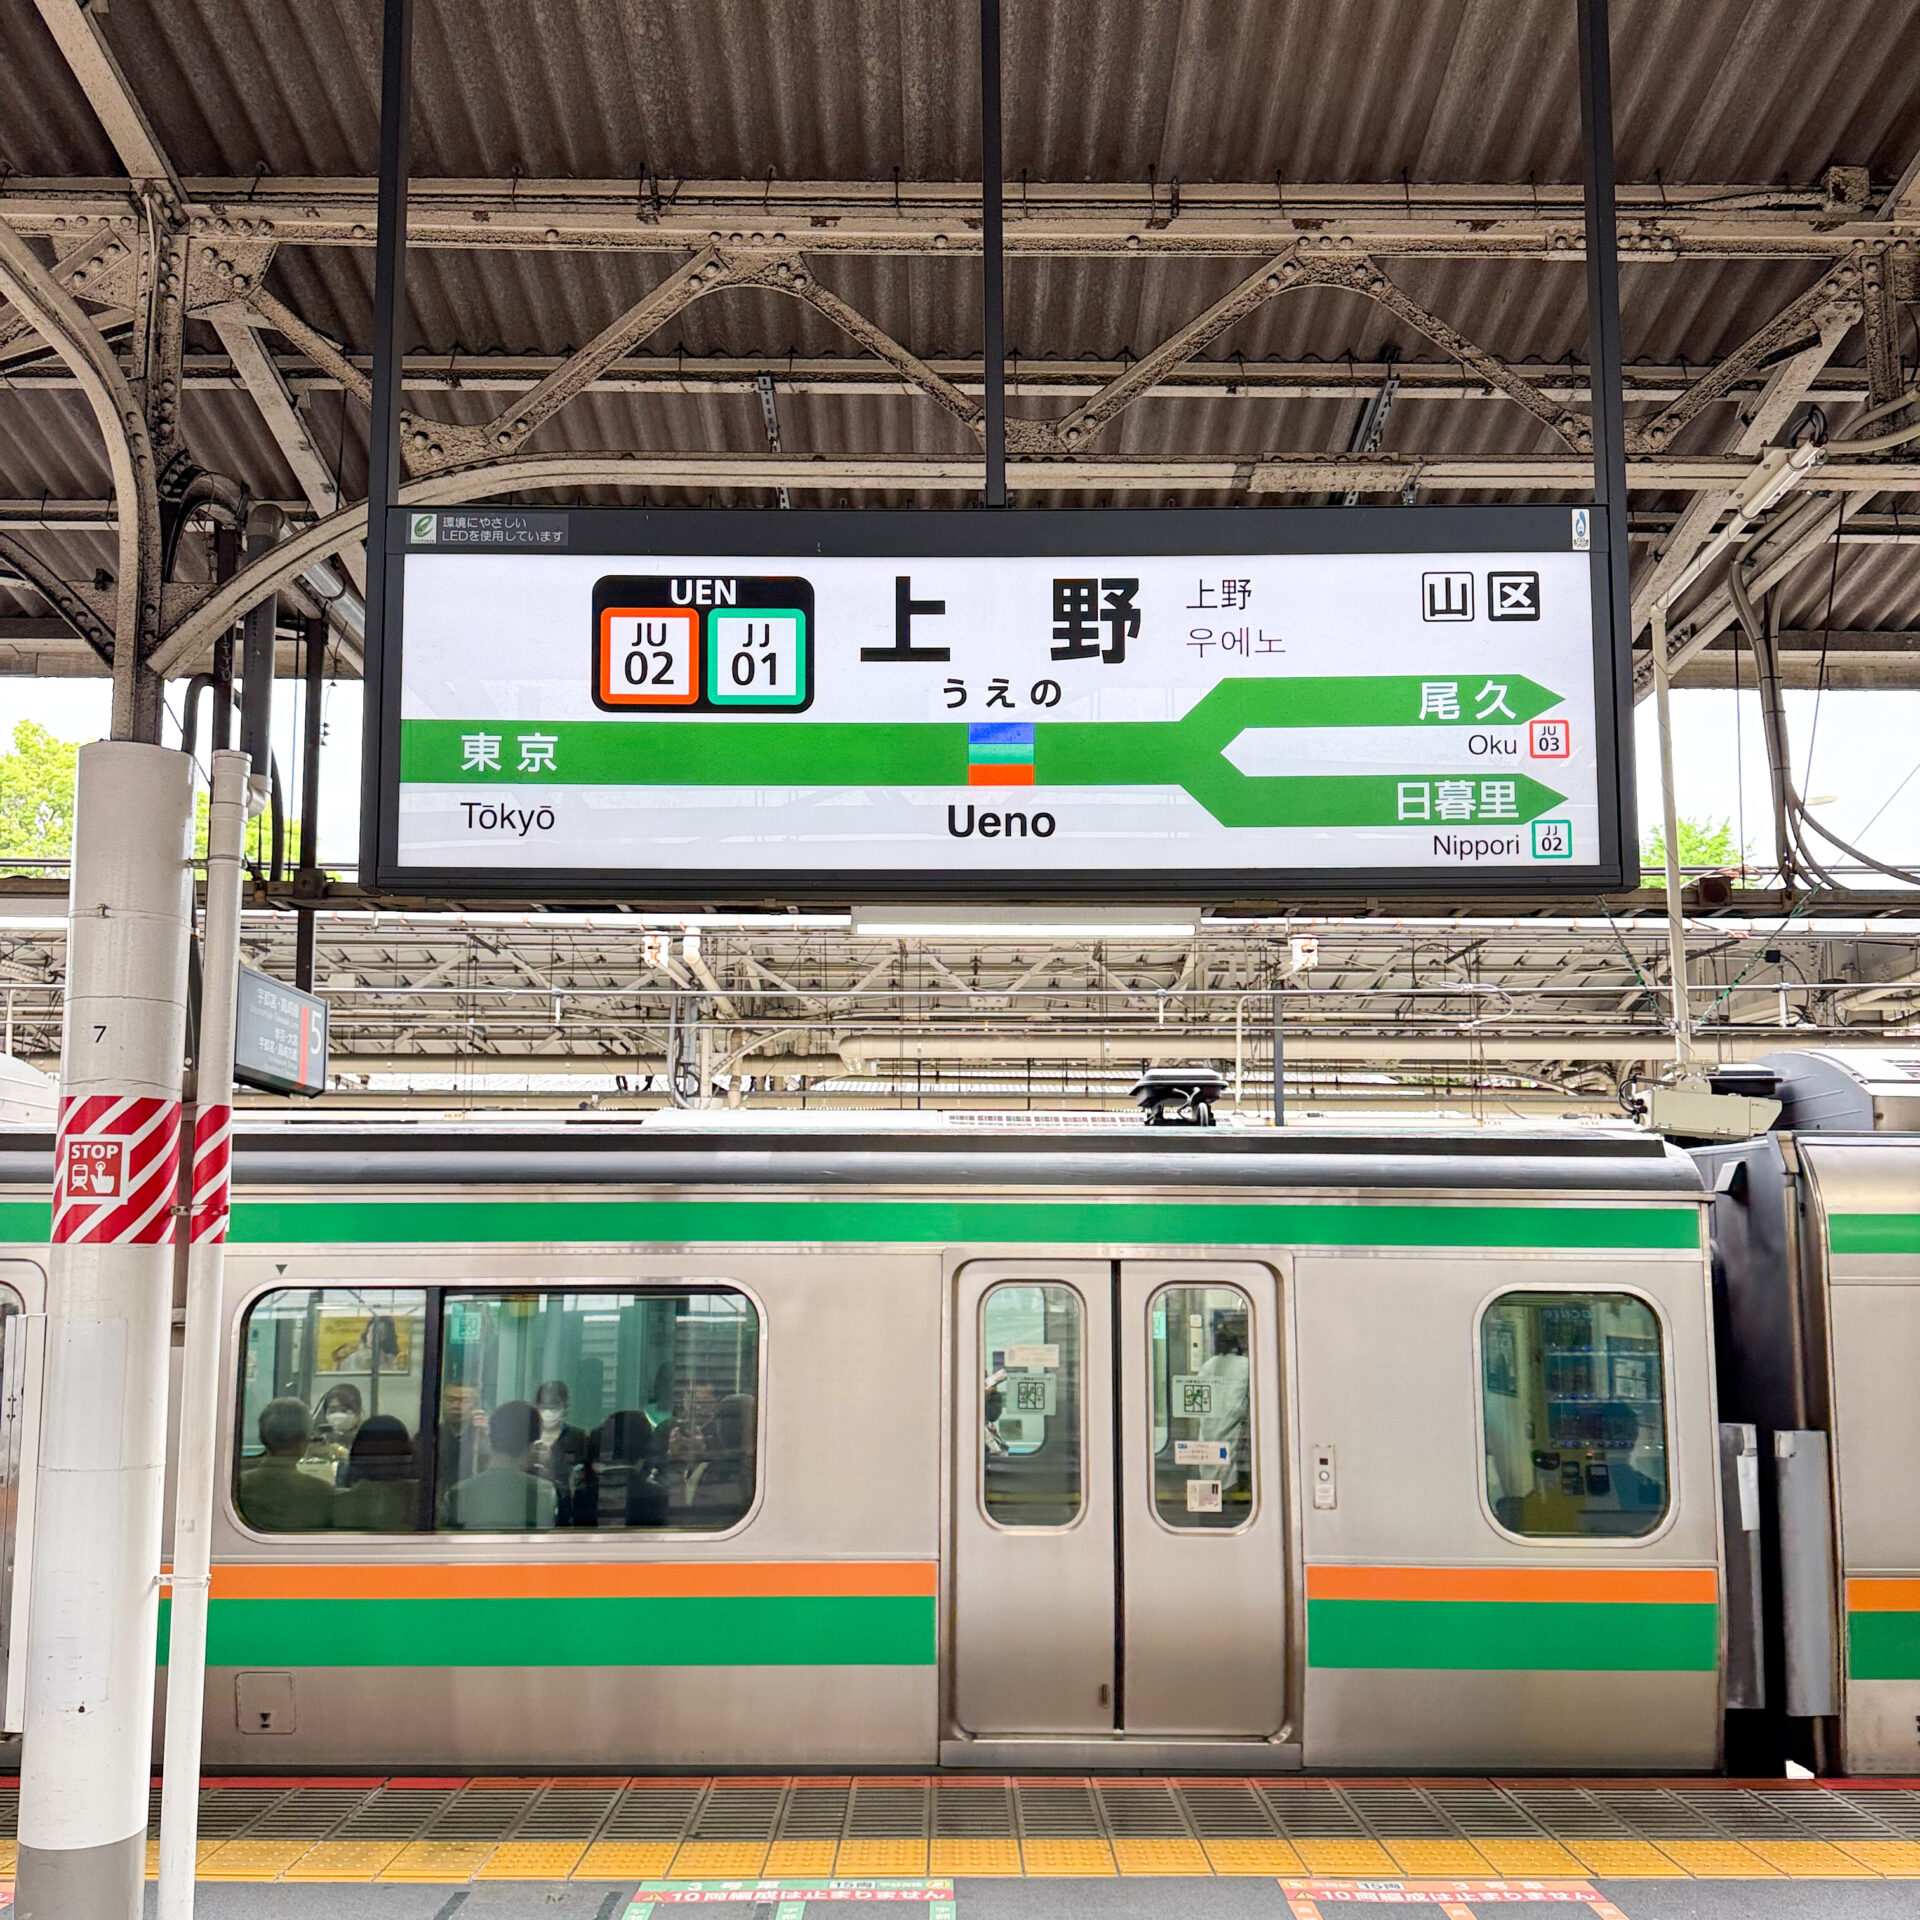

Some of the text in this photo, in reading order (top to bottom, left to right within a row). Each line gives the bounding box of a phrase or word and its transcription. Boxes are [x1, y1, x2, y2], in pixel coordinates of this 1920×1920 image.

[442, 516, 527, 529] 環境にやさしい
[442, 530, 564, 543] LEDを使用しています
[670, 579, 737, 605] UEN
[1186, 578, 1253, 610] 上野
[1429, 576, 1536, 617] 山 区
[860, 576, 1141, 664] 上野
[631, 622, 667, 647] JU
[742, 623, 770, 648] JJ
[1186, 626, 1286, 658] 우에노
[624, 651, 675, 685] 02
[731, 652, 777, 686] 01
[943, 678, 1062, 709] うえの
[1418, 679, 1517, 721] 尾久
[1541, 725, 1557, 736] JU
[460, 731, 560, 773] 東京
[1468, 734, 1517, 755] Oku
[1539, 737, 1560, 751] 03
[1396, 779, 1520, 821] 日暮里
[459, 802, 555, 837] Tōkyō
[947, 804, 1056, 838] Ueno
[1545, 825, 1558, 836] JJ
[1433, 834, 1520, 861] Nippori
[1541, 837, 1563, 851] 02
[93, 1025, 107, 1044] 7
[310, 1010, 322, 1056] 5
[71, 1144, 119, 1159] STOP
[671, 1890, 946, 1902] 10両編成は止まりません
[1320, 1890, 1596, 1902] 10両編成は止まりません
